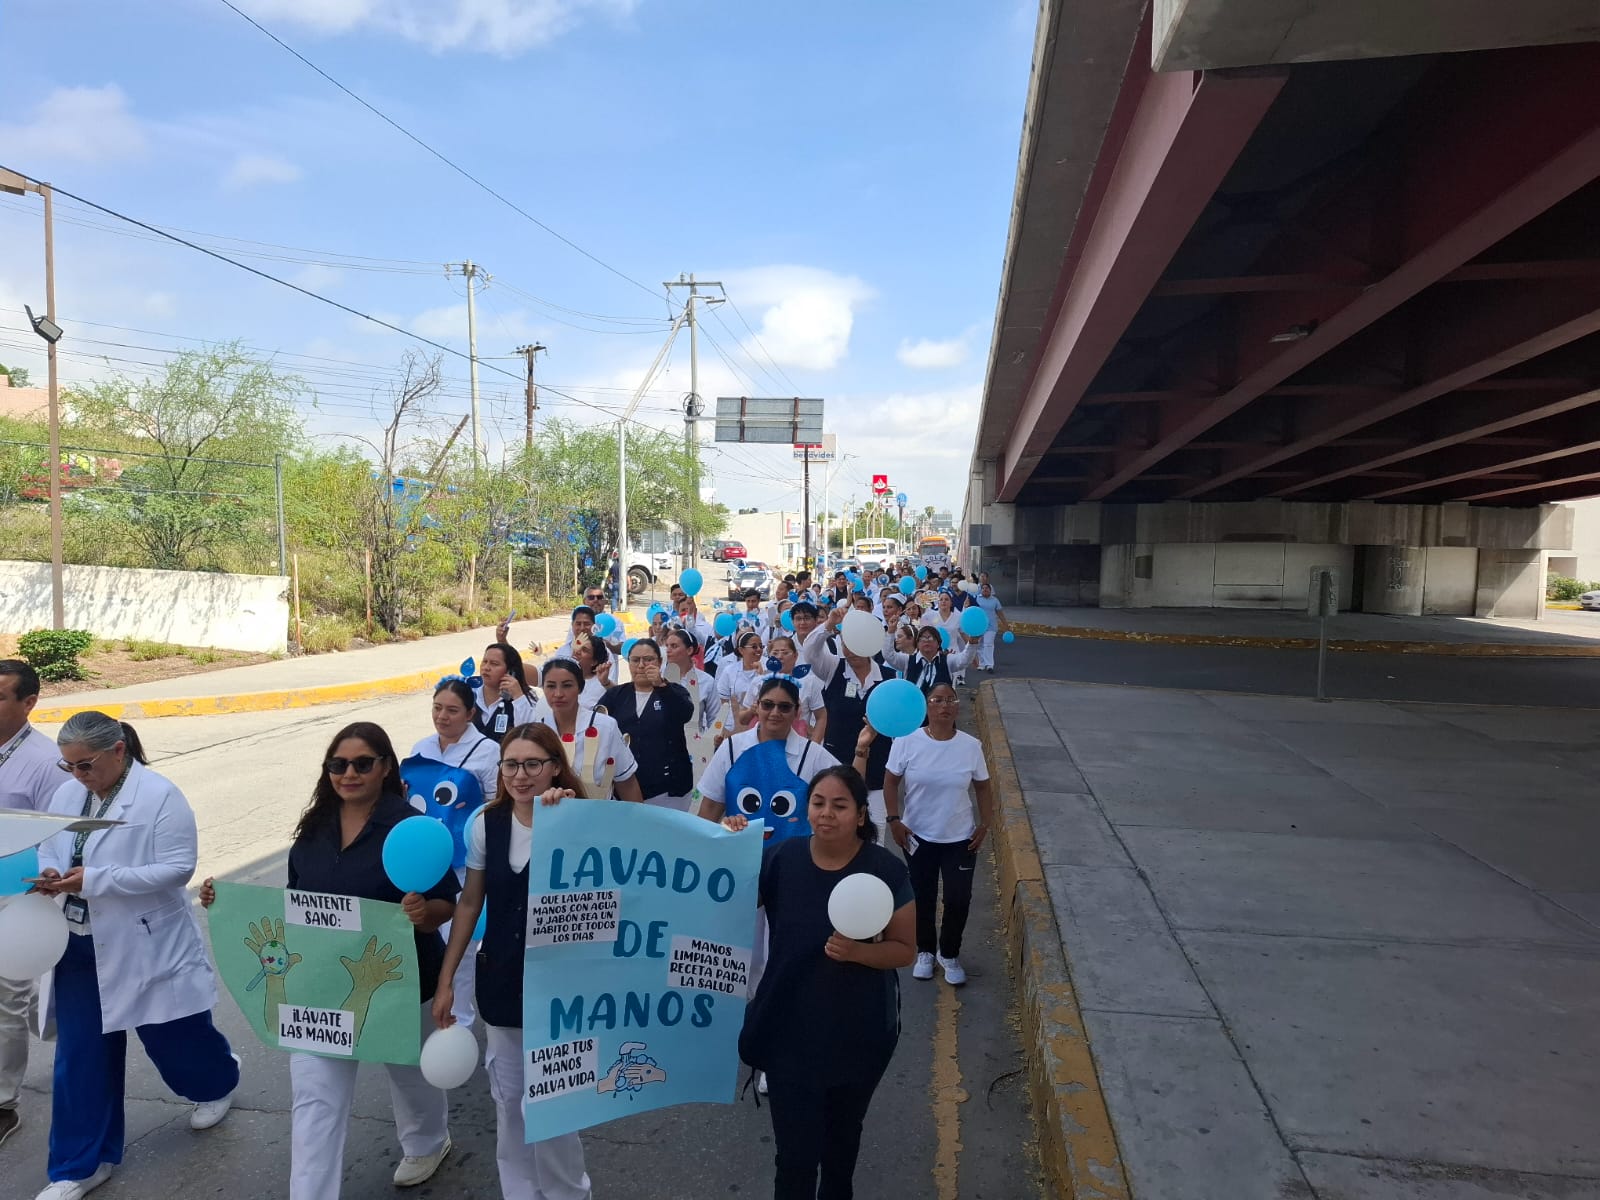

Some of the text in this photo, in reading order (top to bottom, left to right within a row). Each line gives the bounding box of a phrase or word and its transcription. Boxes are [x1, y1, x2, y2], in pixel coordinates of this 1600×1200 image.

[550, 847, 735, 902] LAVADO
[291, 893, 352, 911] MANTENTE
[541, 891, 613, 904] QUE LAVAR TUS
[533, 901, 616, 915] MANOS CON AGUA
[305, 911, 341, 927] SANO:
[546, 912, 578, 924] JABÓN
[580, 913, 597, 921] SEA
[600, 912, 613, 920] UN
[533, 921, 615, 935] HÁBITO DE TODOS
[553, 932, 594, 943] LOS DIAS
[613, 920, 668, 957] DE
[691, 939, 732, 956] MANOS
[674, 950, 745, 972] LIMPIAS UNA
[670, 962, 747, 985] RECETA PARA
[680, 976, 734, 993] LA SALUD
[293, 1007, 341, 1027] ¡LÁVATE
[550, 991, 714, 1040] MANOS
[281, 1024, 351, 1047] LAS MANOS!
[531, 1039, 593, 1063] LAVAR TUS
[543, 1057, 582, 1076] MANOS
[528, 1071, 594, 1098] SALVA VIDA
